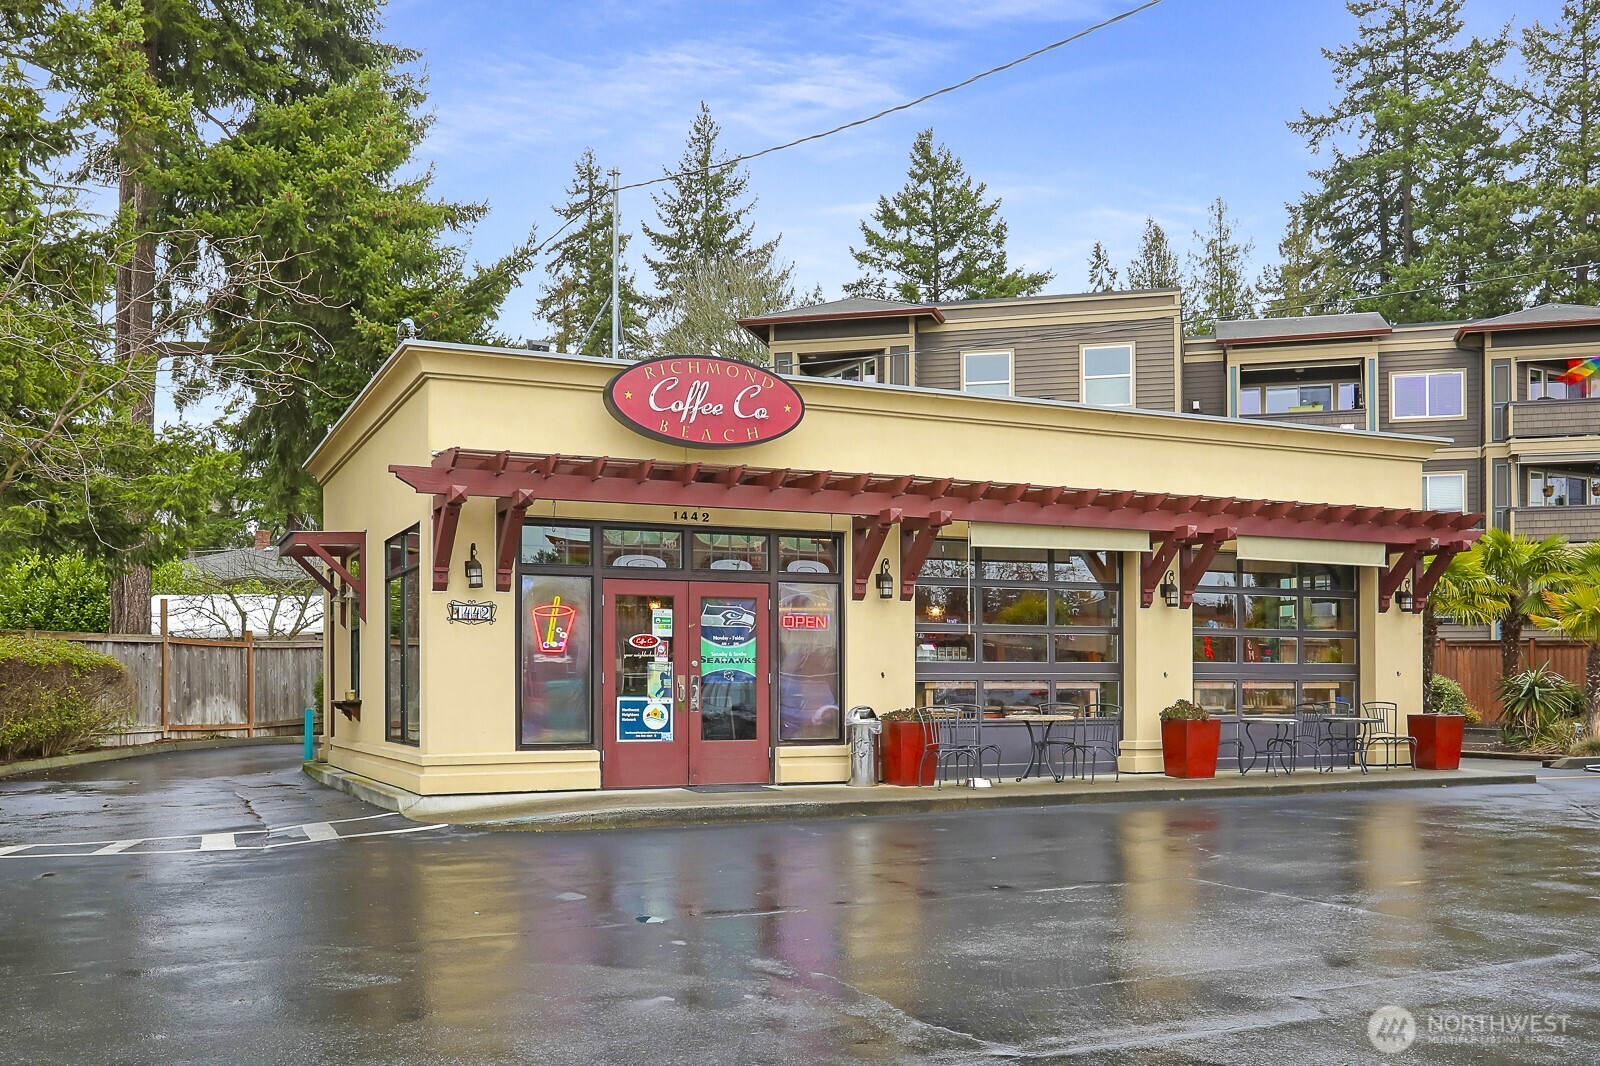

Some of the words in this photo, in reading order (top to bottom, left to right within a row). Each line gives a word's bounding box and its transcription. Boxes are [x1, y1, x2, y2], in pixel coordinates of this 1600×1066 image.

[643, 361, 775, 390] RICHMOND
[648, 376, 724, 424] Coffee
[733, 384, 770, 420] Co
[659, 419, 760, 442] BEACH
[673, 510, 710, 523] 1442
[453, 605, 490, 620] 1442
[782, 615, 828, 629] OPEN
